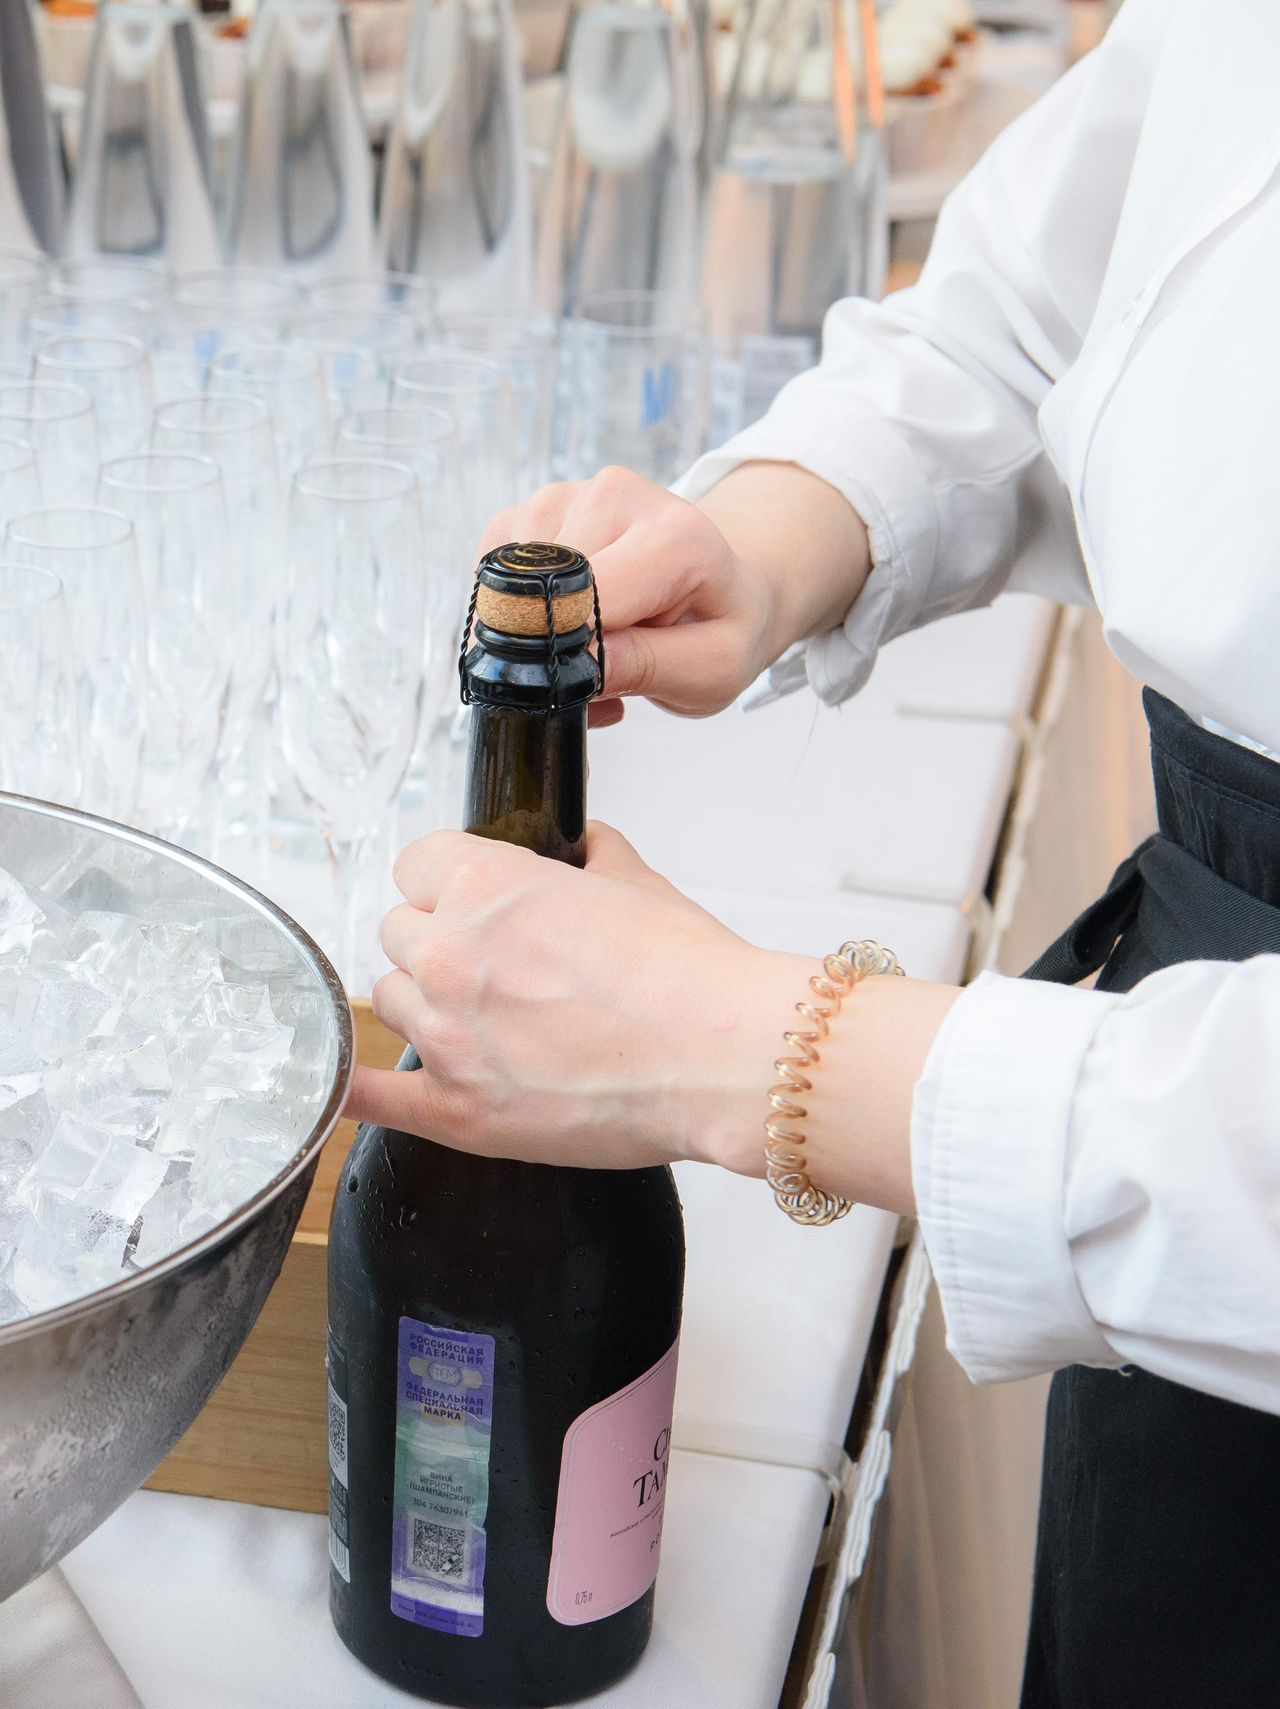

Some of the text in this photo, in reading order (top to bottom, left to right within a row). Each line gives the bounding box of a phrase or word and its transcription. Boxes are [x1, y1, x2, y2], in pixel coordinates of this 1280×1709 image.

[410, 1333, 483, 1355] РОССИЙСКАЯ
[410, 1342, 483, 1365] ФЕДЕРАЦИЯ
[406, 1382, 483, 1406] ФЕДЕРАЛЬНАЯ
[406, 1391, 483, 1415] СПЕЦИАЛЬНАЯ
[424, 1406, 461, 1420] МАРКА
[420, 1477, 463, 1493] ИГРИСТЫЕ
[430, 1472, 453, 1483] ВИНА
[410, 1482, 475, 1504] (ШАМПАНСКИЕ)
